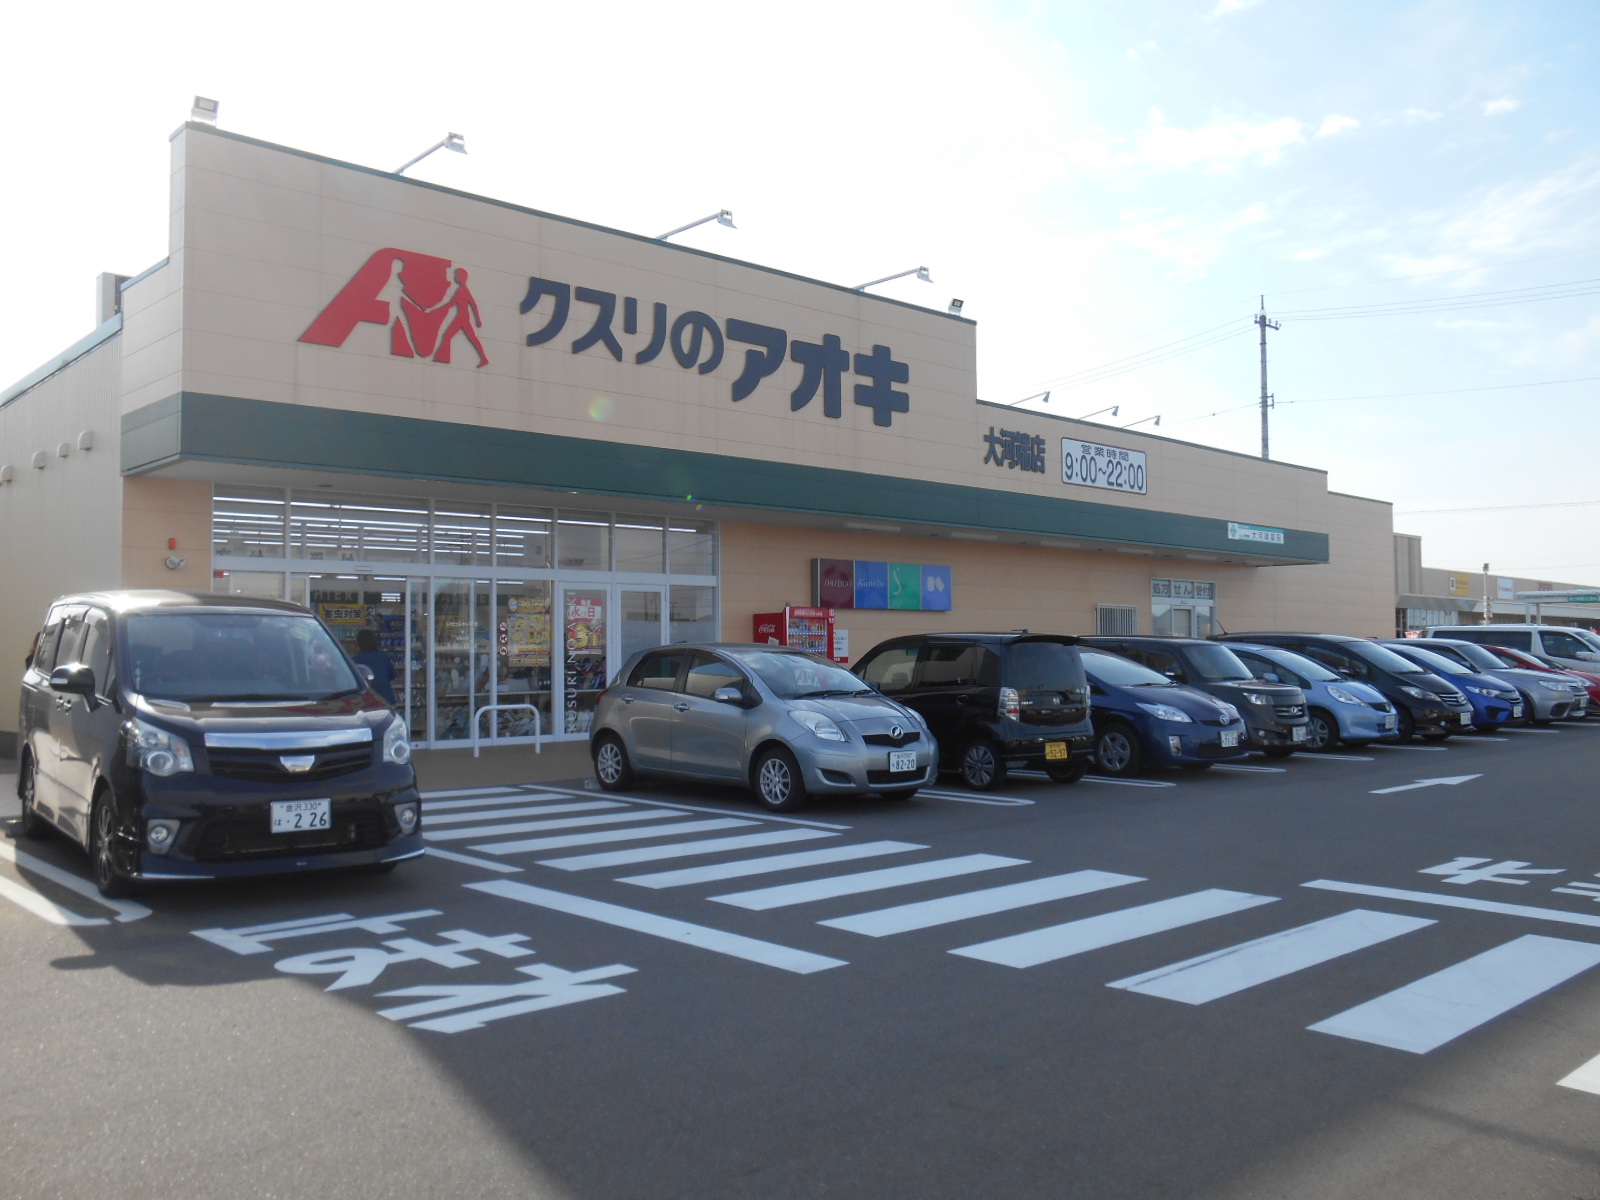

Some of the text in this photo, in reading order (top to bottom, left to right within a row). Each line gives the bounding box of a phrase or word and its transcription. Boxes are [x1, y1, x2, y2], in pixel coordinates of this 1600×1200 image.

[519, 276, 910, 428] クスリのアオキ
[983, 426, 1047, 474] 大河端店
[1080, 444, 1130, 462] 営業時間
[857, 578, 887, 588] Kanebo
[1152, 582, 1212, 597] 処方せん受付
[323, 609, 363, 619] 害虫対策
